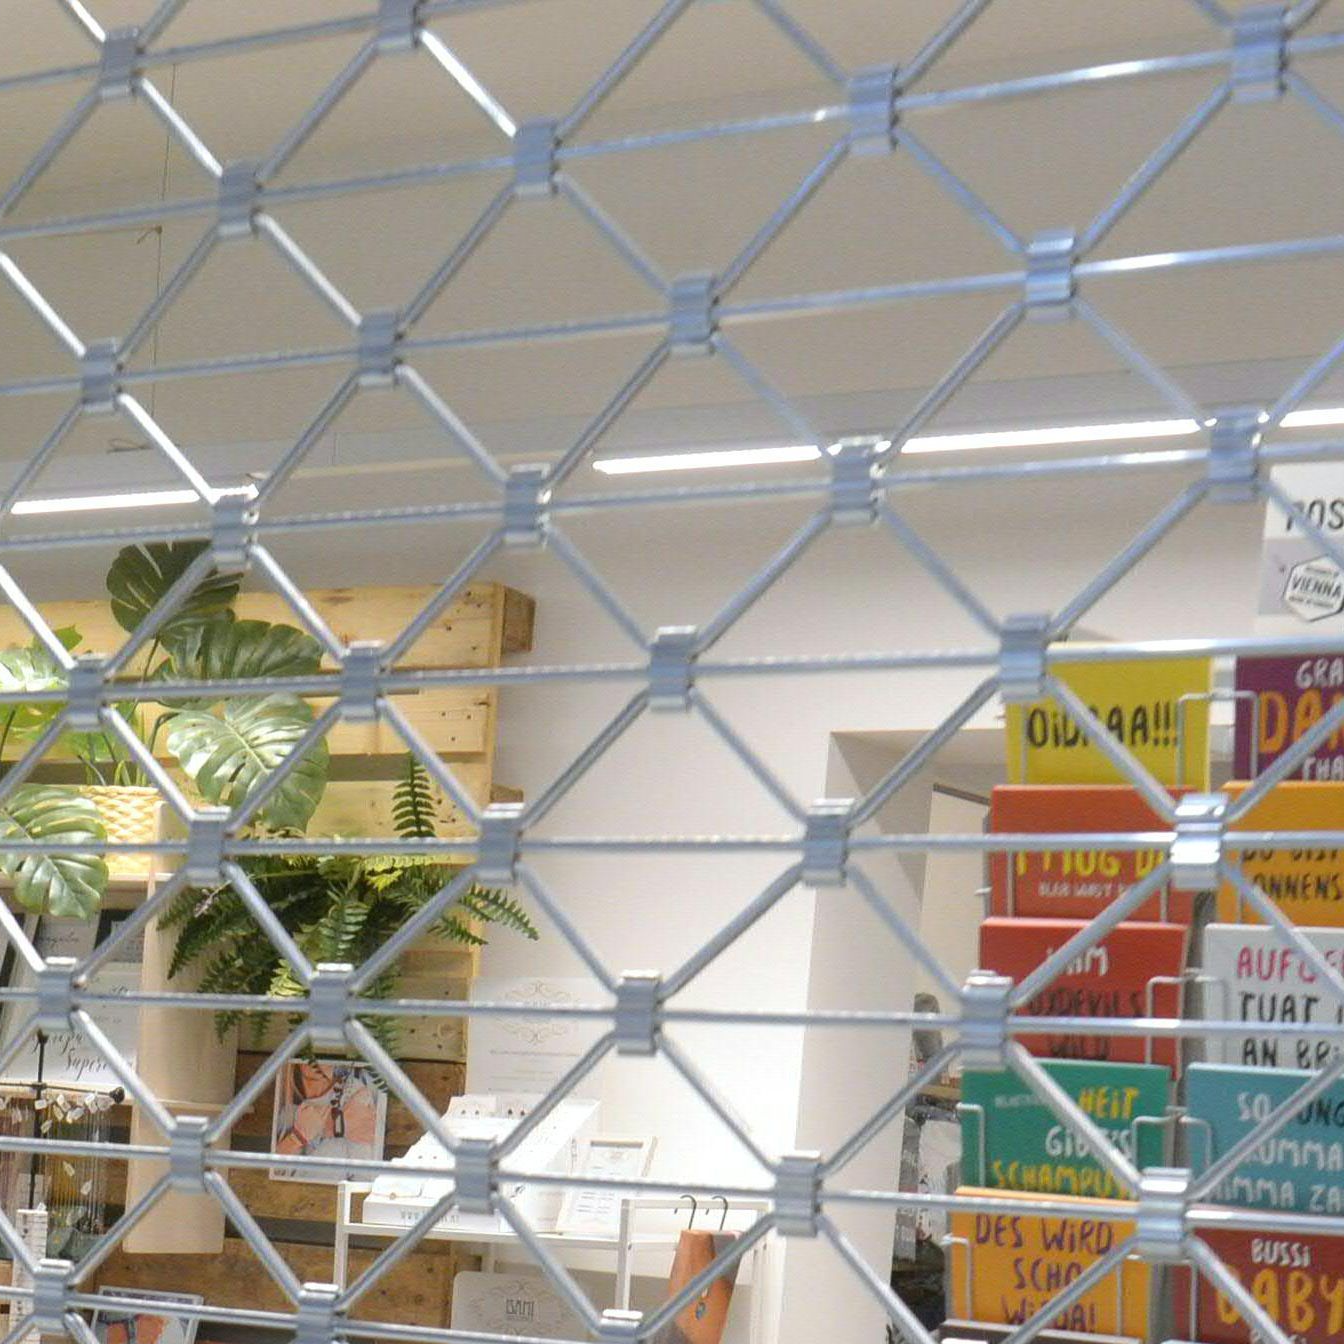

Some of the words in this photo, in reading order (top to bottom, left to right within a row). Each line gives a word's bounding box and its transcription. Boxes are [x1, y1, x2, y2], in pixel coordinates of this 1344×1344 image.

[1292, 575, 1343, 598] VIENNA
[1239, 991, 1319, 1024] TUAT
[1242, 1038, 1277, 1067] AN
[1297, 1038, 1340, 1070] BR
[1238, 1092, 1271, 1121] SO
[1244, 1138, 1344, 1171] UMMA
[975, 1213, 1024, 1248] DES
